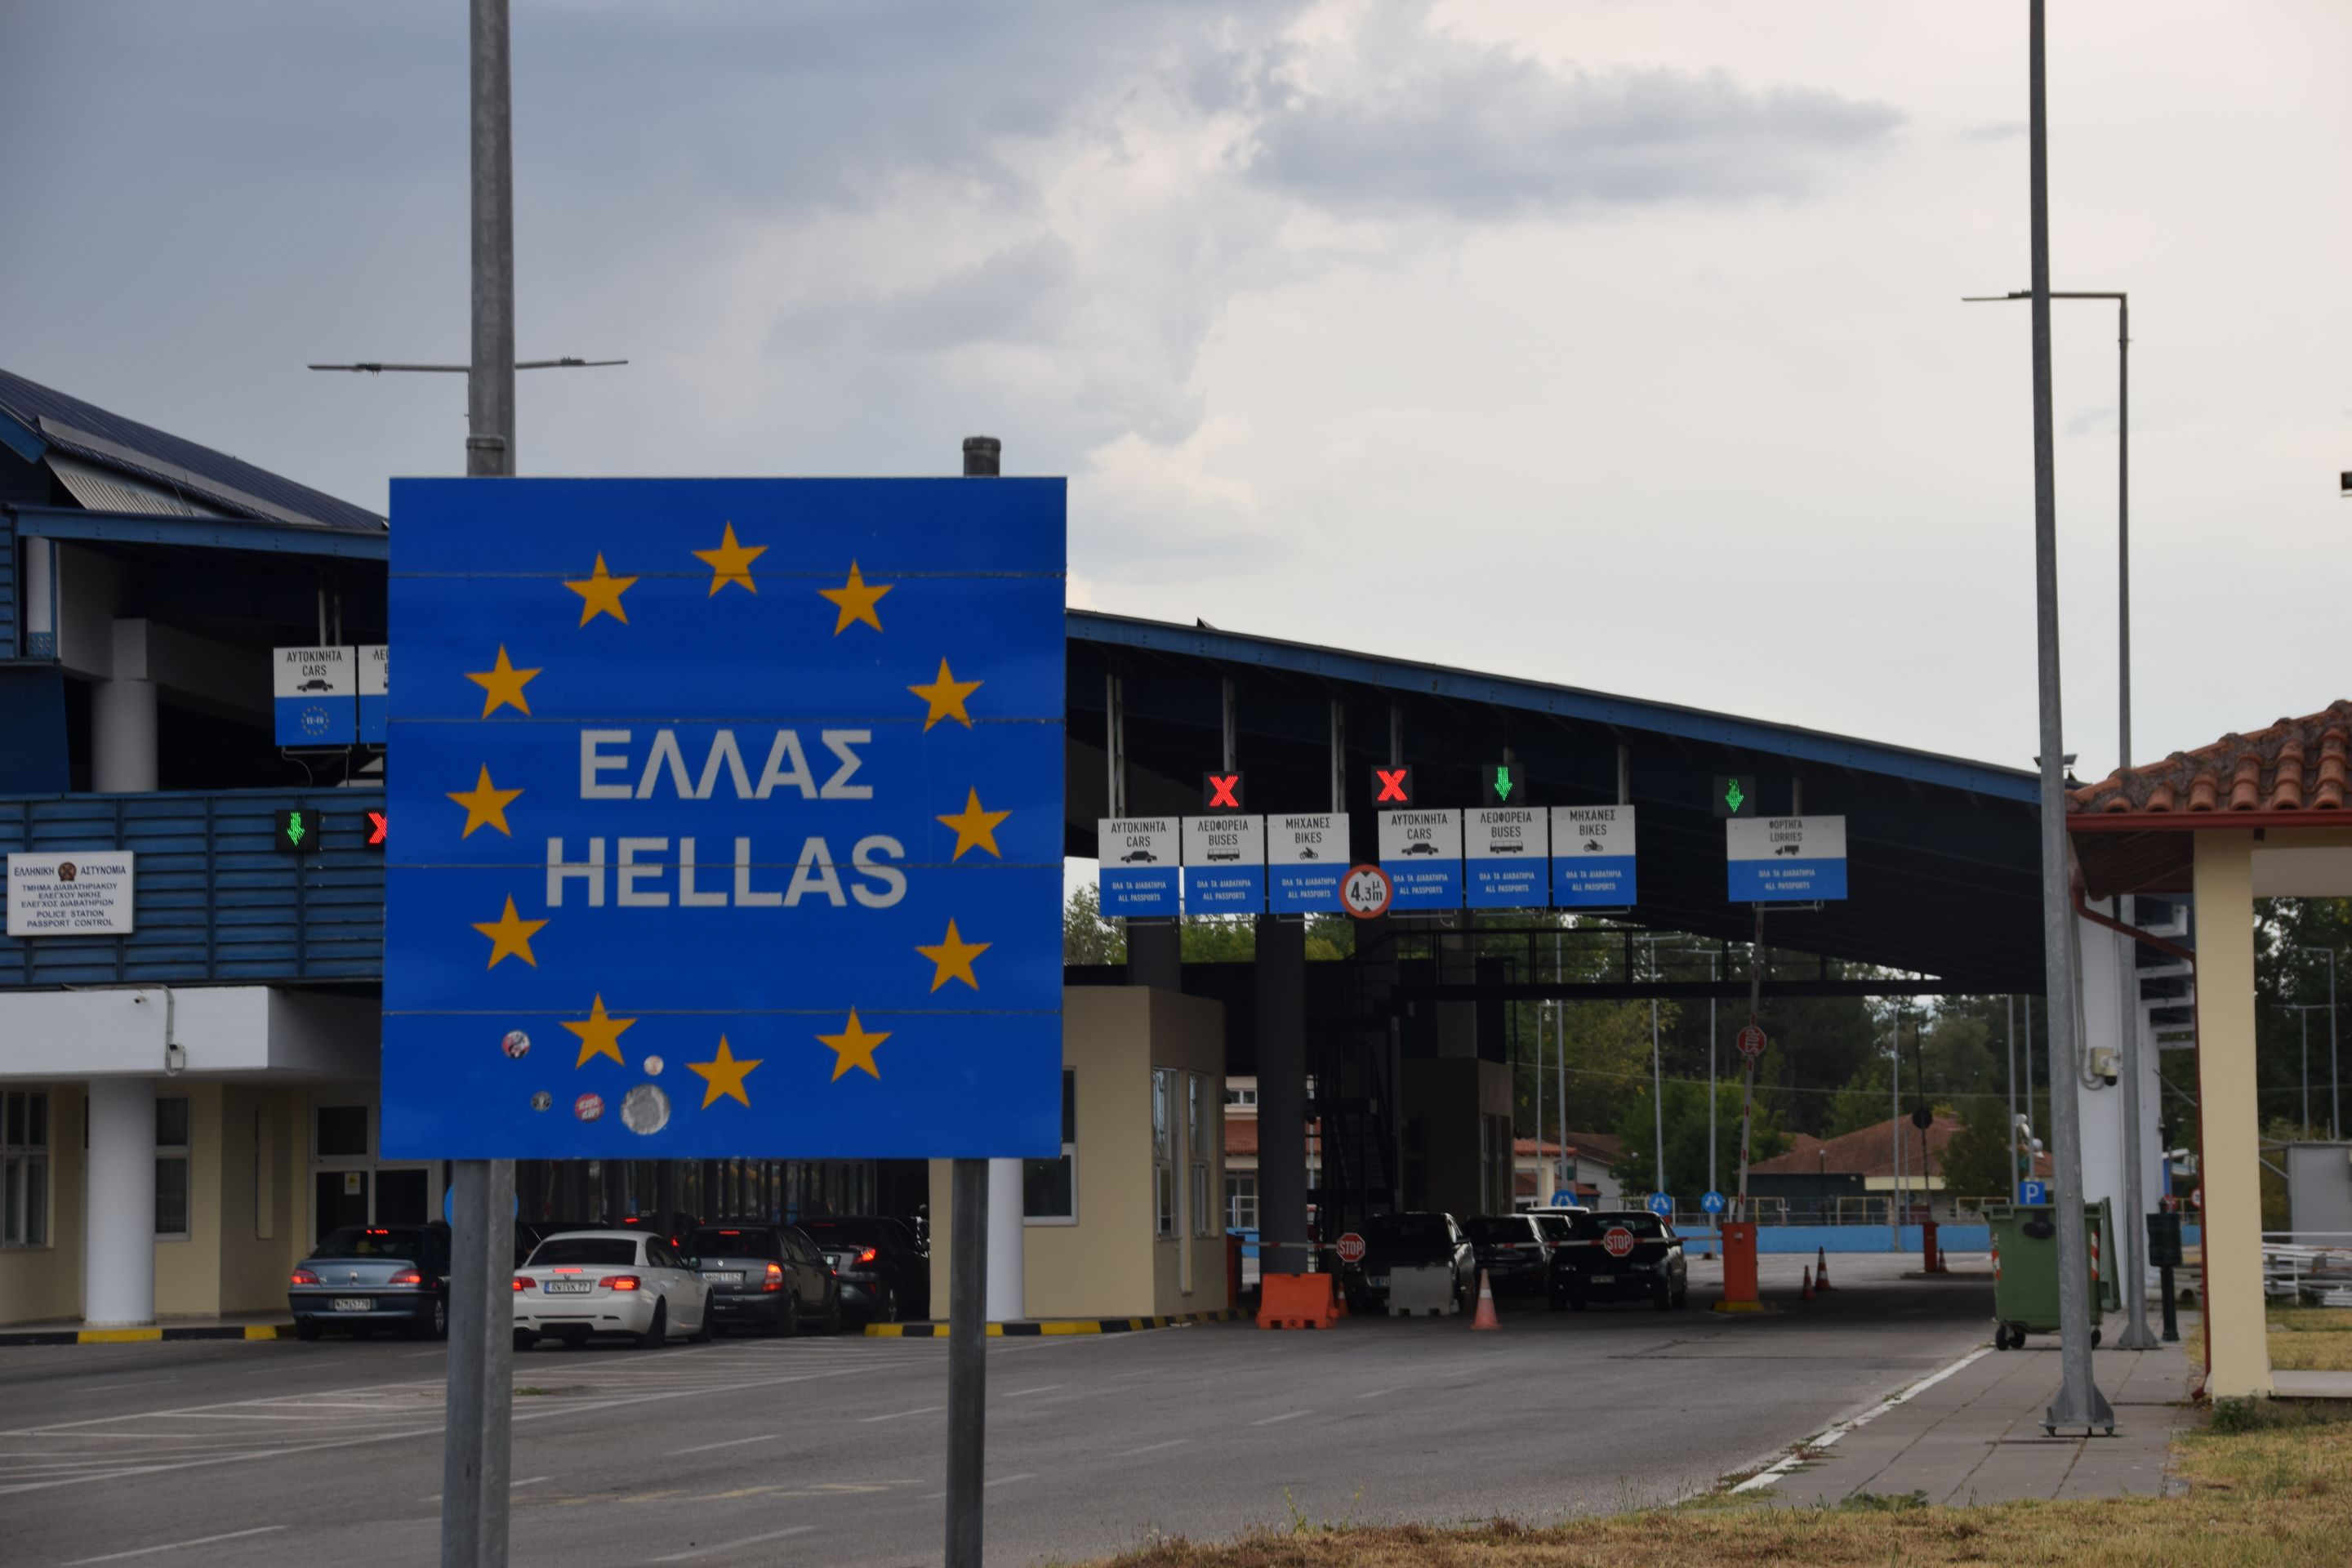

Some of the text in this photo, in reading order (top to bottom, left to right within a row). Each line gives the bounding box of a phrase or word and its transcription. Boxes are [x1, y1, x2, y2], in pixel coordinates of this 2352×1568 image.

[287, 651, 342, 662] ΑΥΤΟΚΙΝΗΤΑ
[302, 665, 327, 676] CARS
[581, 729, 873, 799] ΕΛΛΑΣ
[1392, 813, 1447, 826] ΑΥΤΟΚΙΝΗΤΑ
[1480, 812, 1532, 823] ΛΕΩΦΟΡΕΙΑ
[1570, 809, 1615, 822] ΜΗΧΑΝΕΣ
[1111, 821, 1166, 833] ΑΥΤΟΚΙΝΗΤΑ
[1197, 819, 1249, 832] ΛΕΩΦΟΡΕΙΑ
[1285, 817, 1330, 829] ΜΗΧΑΝΕΣ
[1769, 819, 1803, 829] ΦΟΡΤΗΓΑ
[1407, 827, 1432, 840] CARS
[1491, 826, 1521, 838] BUSES
[1579, 824, 1607, 835] BIKES
[1126, 835, 1151, 847] CARS
[1209, 834, 1237, 845] BUSES
[1294, 832, 1321, 844] BIKES
[1771, 832, 1802, 842] LORRIES
[14, 866, 127, 876] ΕΛΛΗΝΙΚΗ ΑΣΤΥΝΟΜΙΑ
[546, 835, 907, 909] HELLAS
[1400, 886, 1410, 894] ALL
[1486, 884, 1529, 893] ALL PASSPORTS
[1572, 882, 1616, 891] ALL PASSPORTS
[1118, 893, 1160, 902] ALL PASSPORTS
[1203, 891, 1245, 900] ALL PASSPORTS
[1288, 889, 1330, 898] ALL PASSPORTS
[27, 920, 70, 928] PASSPORT
[1745, 1029, 1759, 1054] STOP
[2026, 1183, 2039, 1205] P
[1339, 1241, 1363, 1255] STOP
[1607, 1235, 1631, 1250] STOP
